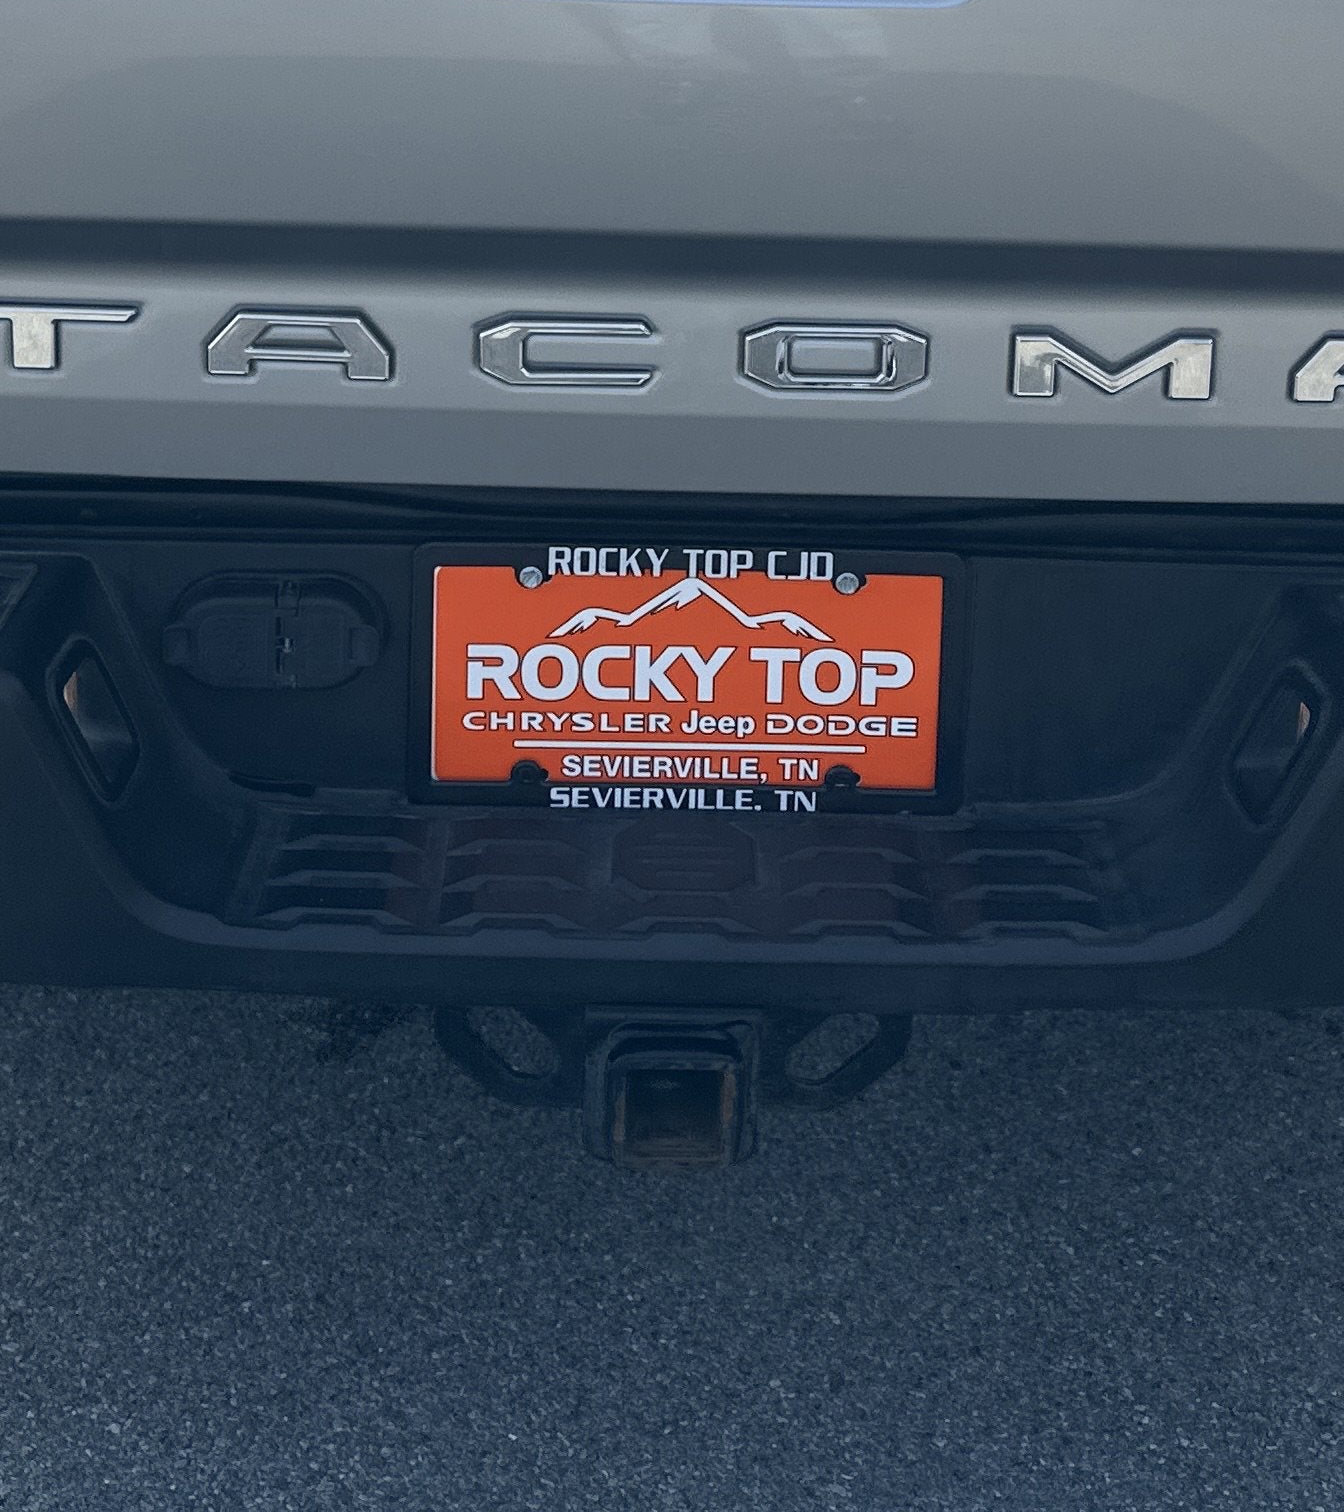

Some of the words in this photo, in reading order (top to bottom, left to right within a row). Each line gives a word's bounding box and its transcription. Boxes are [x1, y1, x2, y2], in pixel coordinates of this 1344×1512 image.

[547, 547, 669, 577] ROCKY
[683, 548, 754, 578] TOP
[767, 551, 835, 581] CJD
[466, 644, 736, 702] ROCKY
[751, 648, 915, 706] TOP
[462, 710, 671, 734] CHRYSLER
[681, 710, 756, 738] Jeep
[766, 714, 918, 737] DODGE
[561, 755, 768, 784] SEVIERVILLE,
[779, 758, 819, 781] TN
[774, 789, 816, 812] TN
